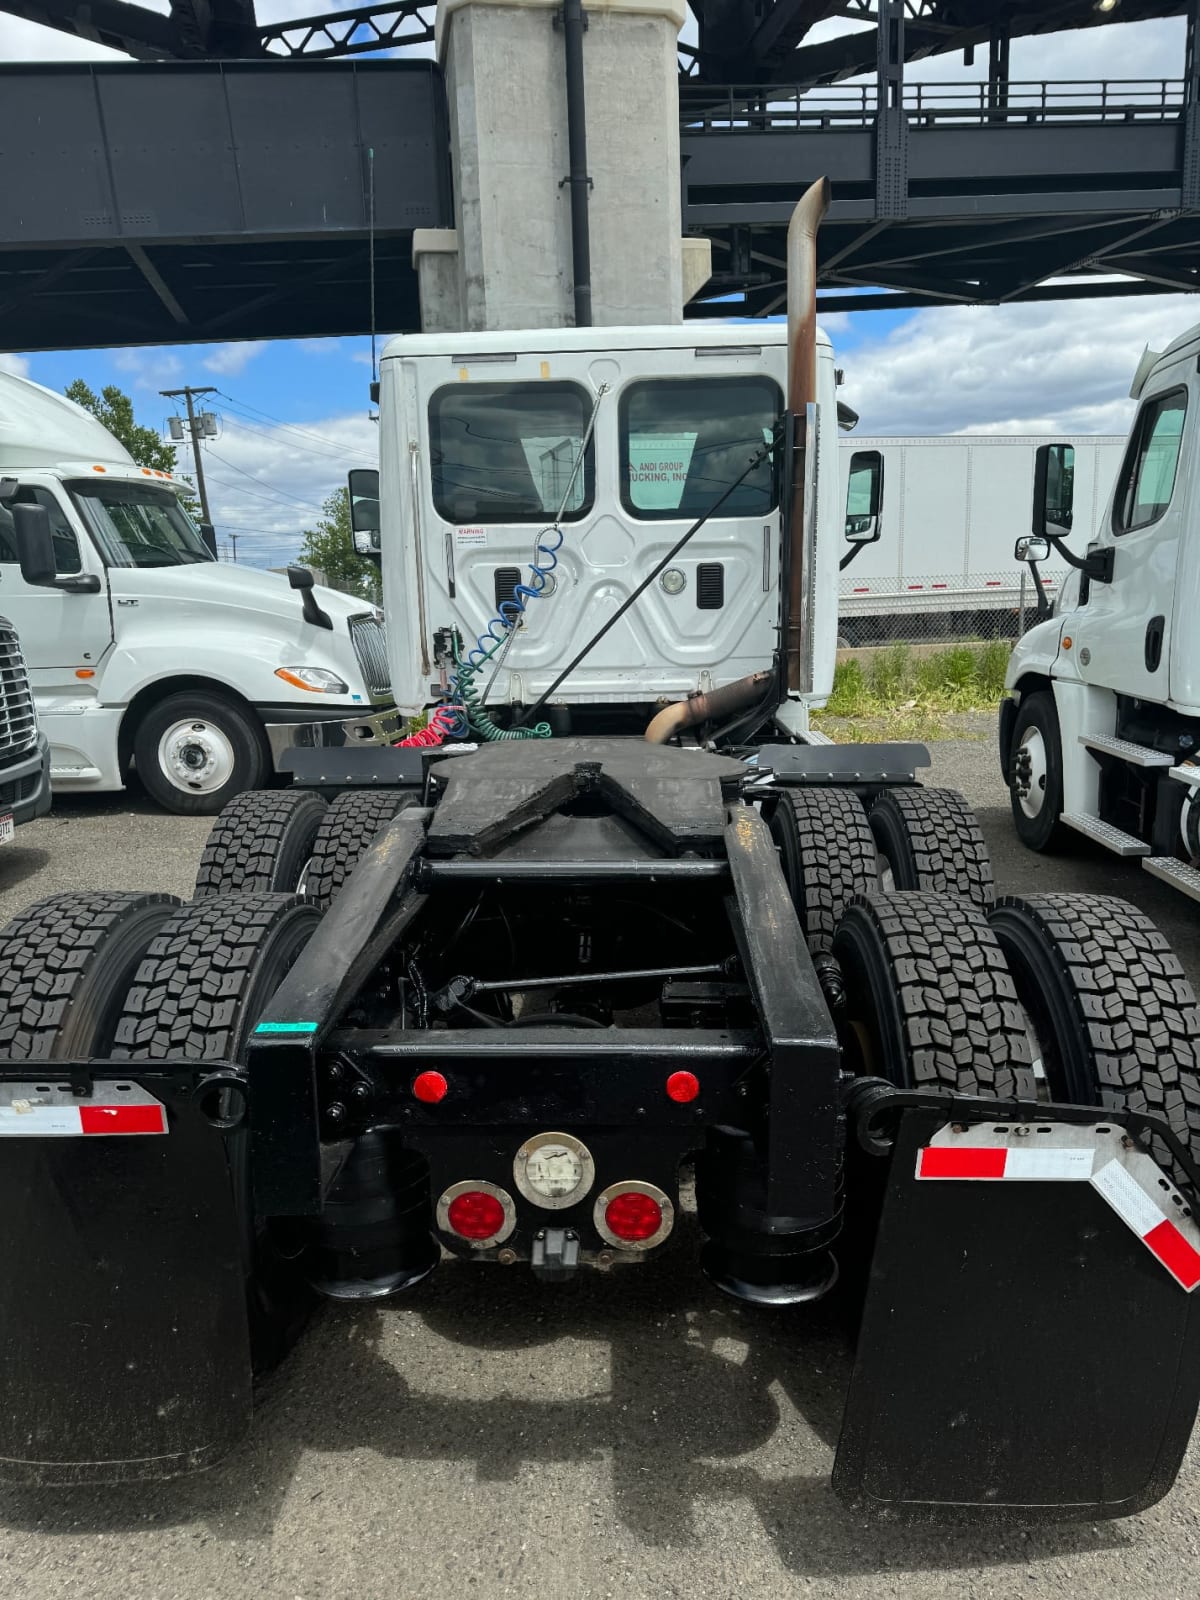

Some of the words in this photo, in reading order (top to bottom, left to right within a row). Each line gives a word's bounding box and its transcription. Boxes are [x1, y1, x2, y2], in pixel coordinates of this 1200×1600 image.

[640, 462, 657, 471] ANDI
[659, 462, 684, 471] GROUP
[630, 472, 670, 483] UCKING,
